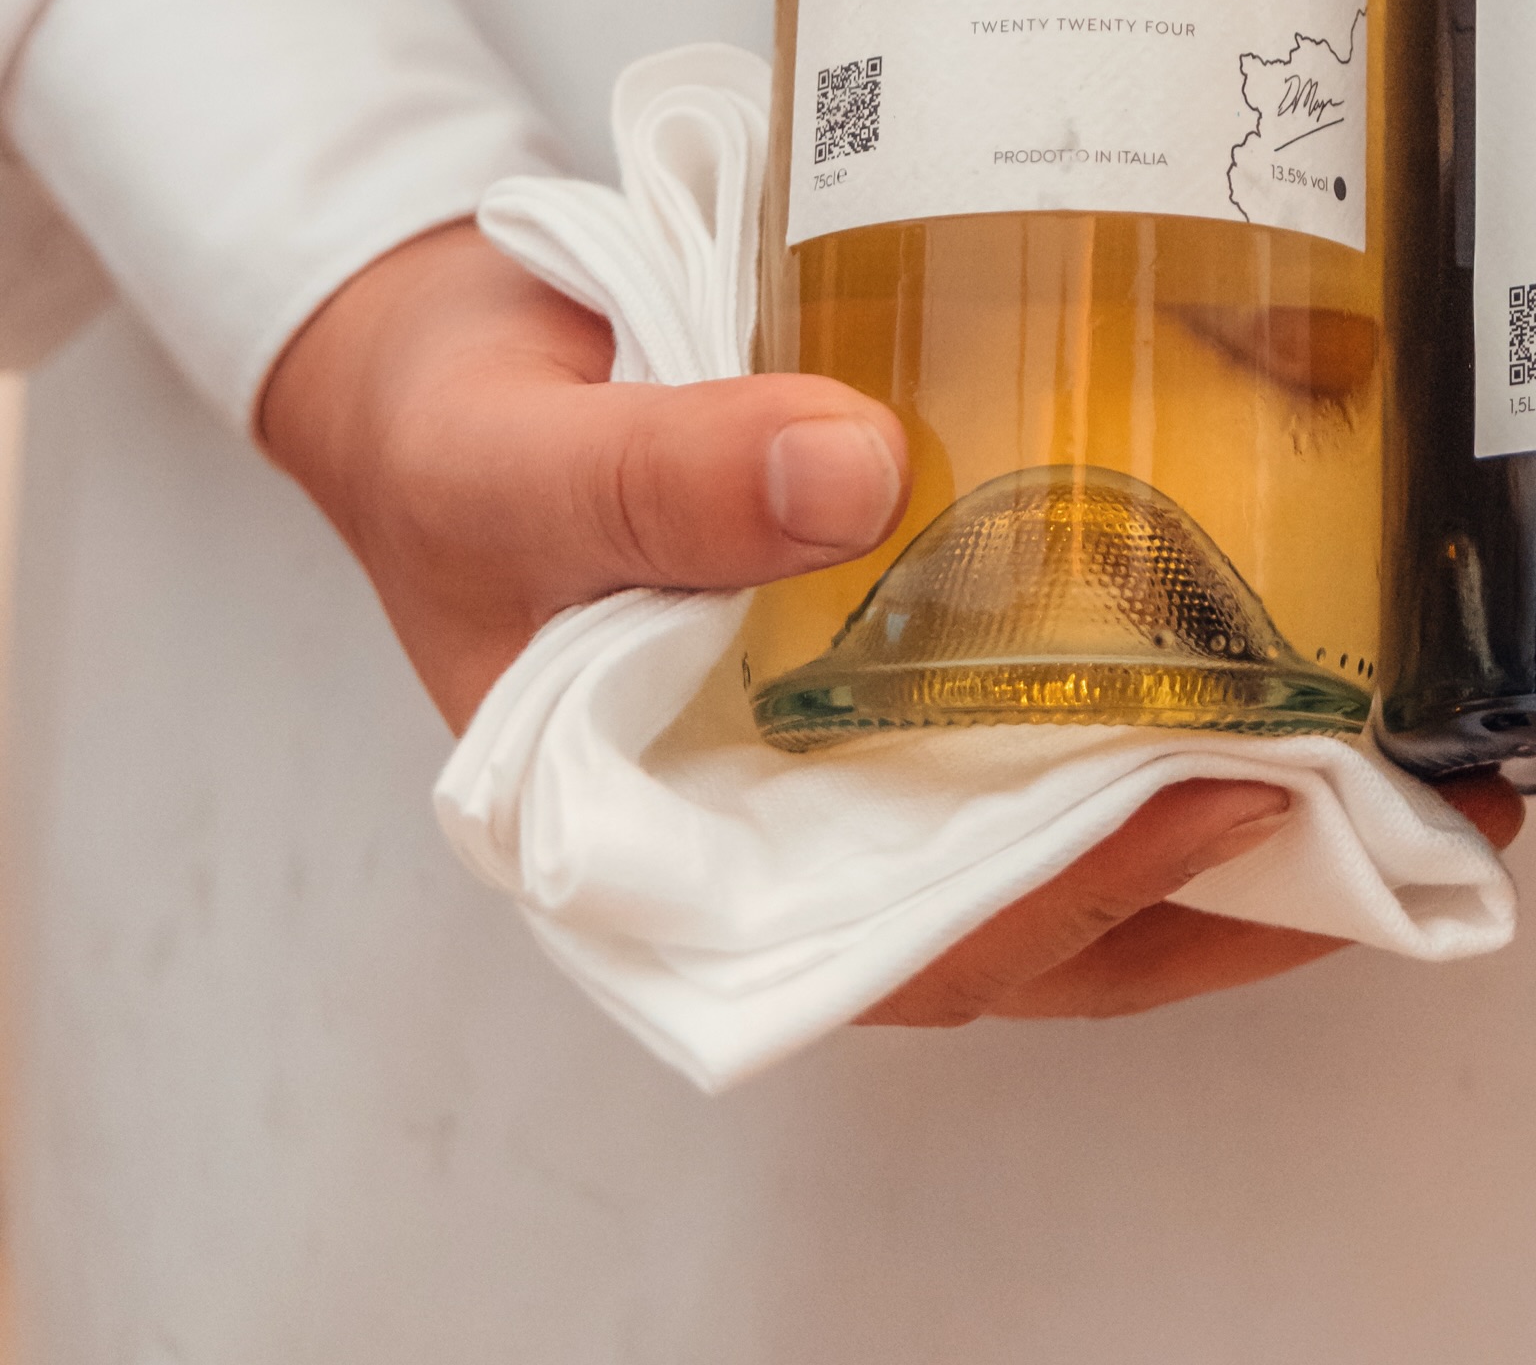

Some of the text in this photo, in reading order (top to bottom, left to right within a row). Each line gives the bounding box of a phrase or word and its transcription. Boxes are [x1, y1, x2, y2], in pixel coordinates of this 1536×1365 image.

[971, 18, 1195, 37] TWENTY TWENTY FOUR
[1095, 151, 1111, 163] IN
[1118, 151, 1168, 166] ITALIA
[1311, 176, 1328, 192] vol
